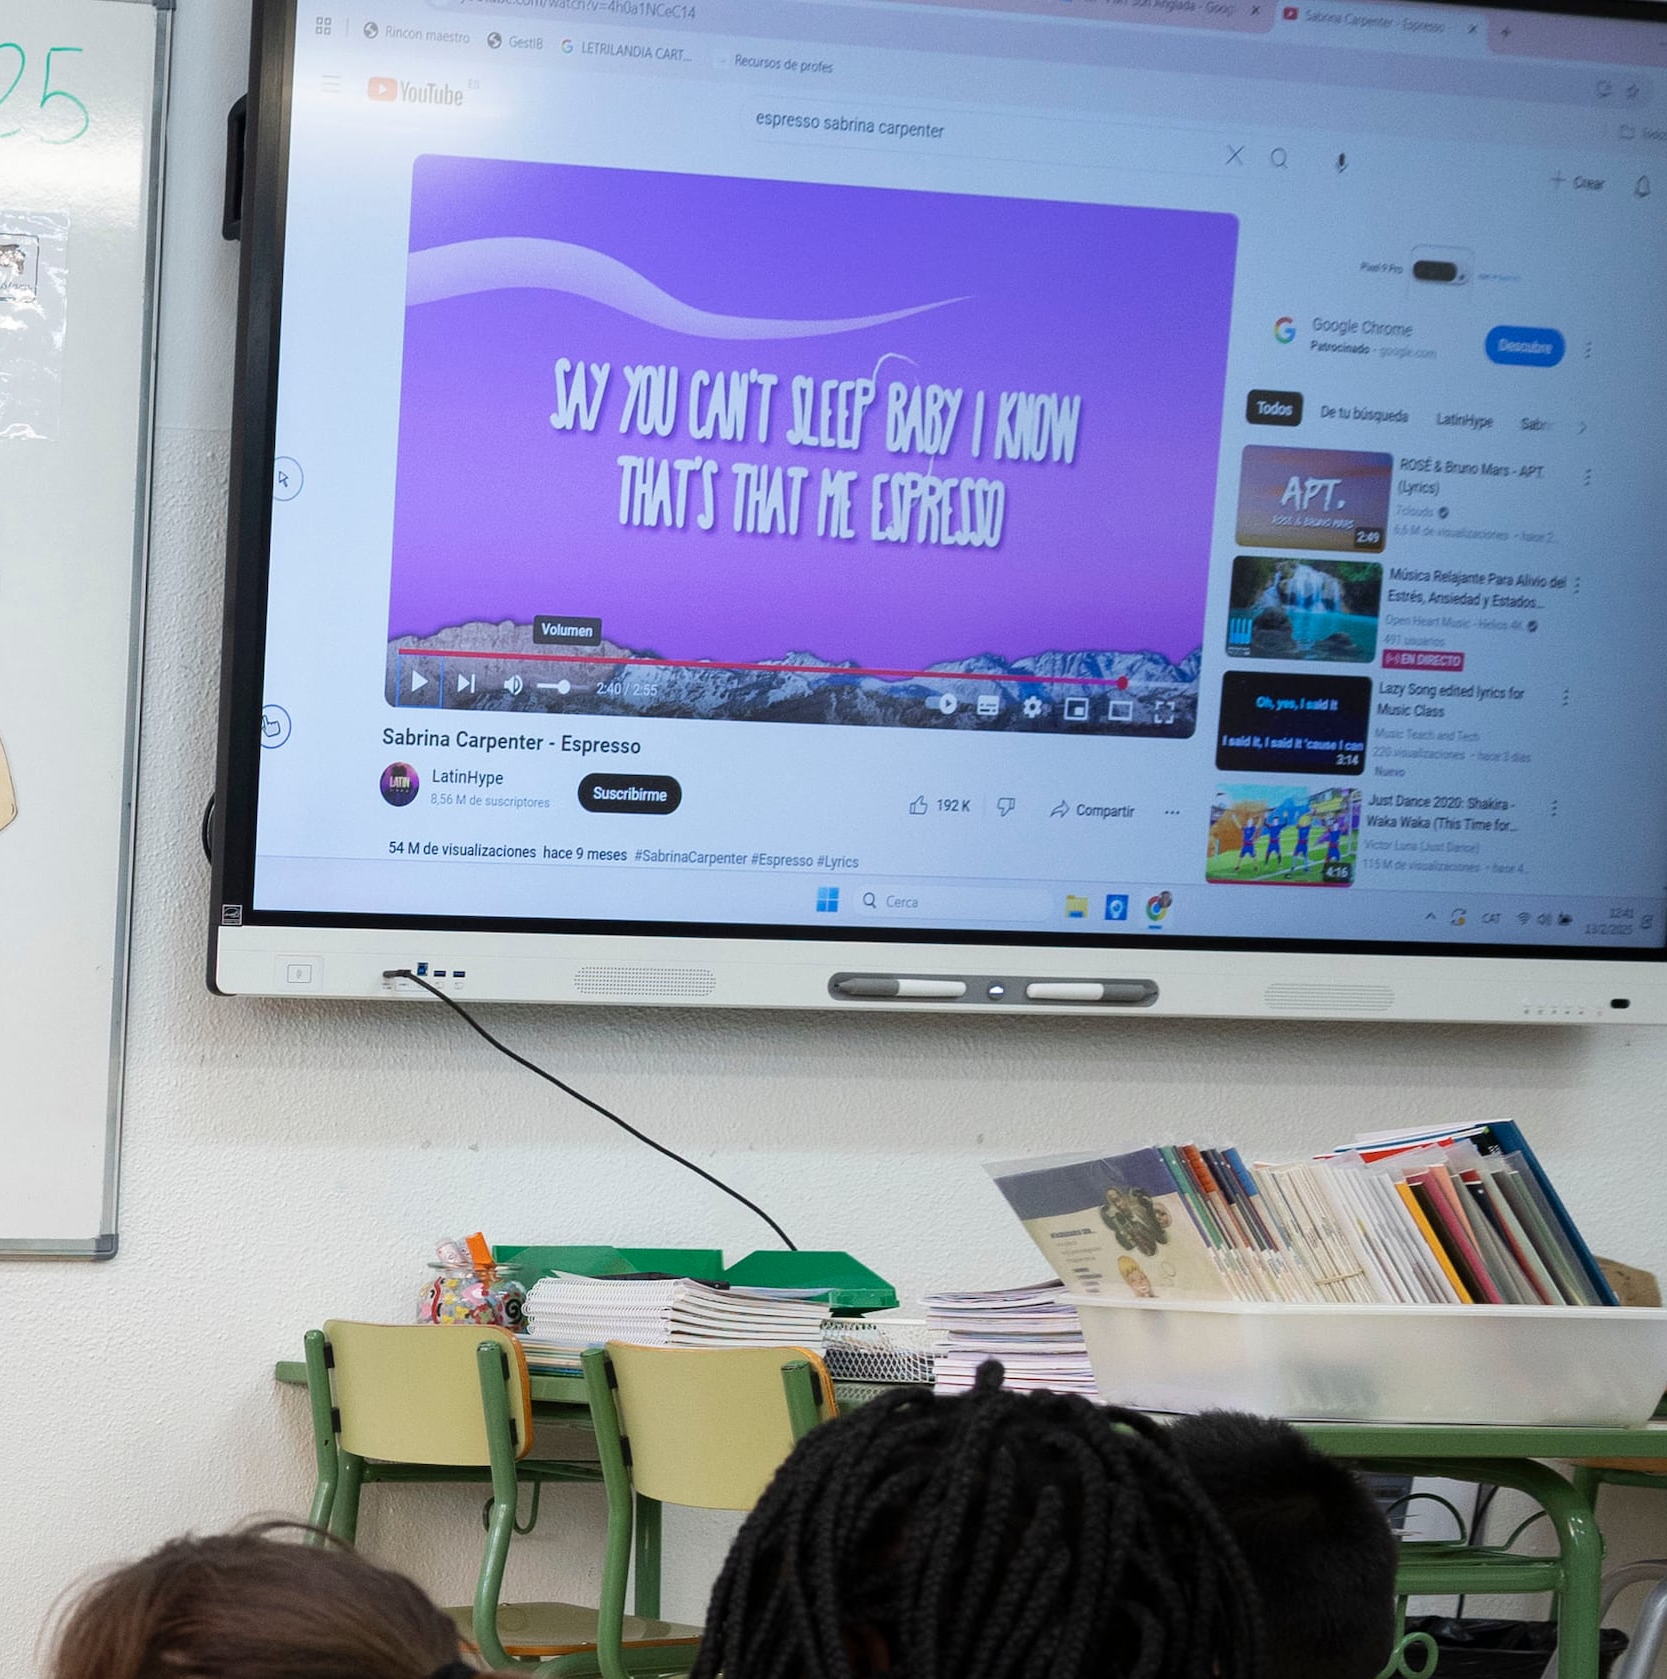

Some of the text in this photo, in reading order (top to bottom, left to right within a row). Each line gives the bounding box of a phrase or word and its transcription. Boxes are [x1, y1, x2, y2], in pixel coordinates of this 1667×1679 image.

[385, 25, 470, 45] Rincon maestro
[581, 42, 654, 60] LETRILANDIA
[734, 54, 834, 75] Recursos de profes
[400, 80, 464, 107] YouTube
[755, 110, 945, 139] espresso sabrina carpenter
[1312, 317, 1414, 338] Google Chrome
[550, 357, 1082, 465] SAY YOU CAN'T SLEEP BABY I KNOW
[1255, 400, 1295, 417] Todos
[1320, 404, 1410, 425] De tu búsqueda
[1445, 460, 1478, 475] Bruno
[1480, 462, 1509, 477] Mars
[1280, 475, 1347, 512] APT.
[1398, 480, 1440, 497] (Lyrics)
[617, 454, 1006, 550] THAT'S THAT ME ESPRESSO
[1389, 567, 1567, 590] Música Relajante Para Alivio del
[1427, 591, 1480, 607] Ansiedad
[541, 622, 594, 639] Volumen
[1417, 653, 1462, 668] DIRECTO
[596, 681, 626, 696] 2:40
[633, 684, 658, 698] 2:55
[1379, 681, 1525, 702] Lazy Song edited lyrics for
[1376, 702, 1446, 719] Music Class
[382, 727, 642, 757] Sabrina Carpenter Espresso
[432, 768, 504, 789] LatinHype
[430, 793, 551, 811] 8,56 M de suscriptores
[592, 786, 668, 803] Suscribirme
[1368, 793, 1393, 807] Just
[1395, 794, 1430, 808] Dance
[1467, 797, 1510, 811] Shakira
[936, 798, 971, 813] 192 K
[1076, 803, 1136, 820] Compartir
[1366, 814, 1397, 829] Waka
[1399, 815, 1431, 829] Waka
[1463, 817, 1493, 832] Time
[388, 841, 860, 871] 54 M de visualizaciones hace 9 meses #SabrinaCarpenter #Espresso #Lyrics
[886, 894, 919, 910] Cerca
